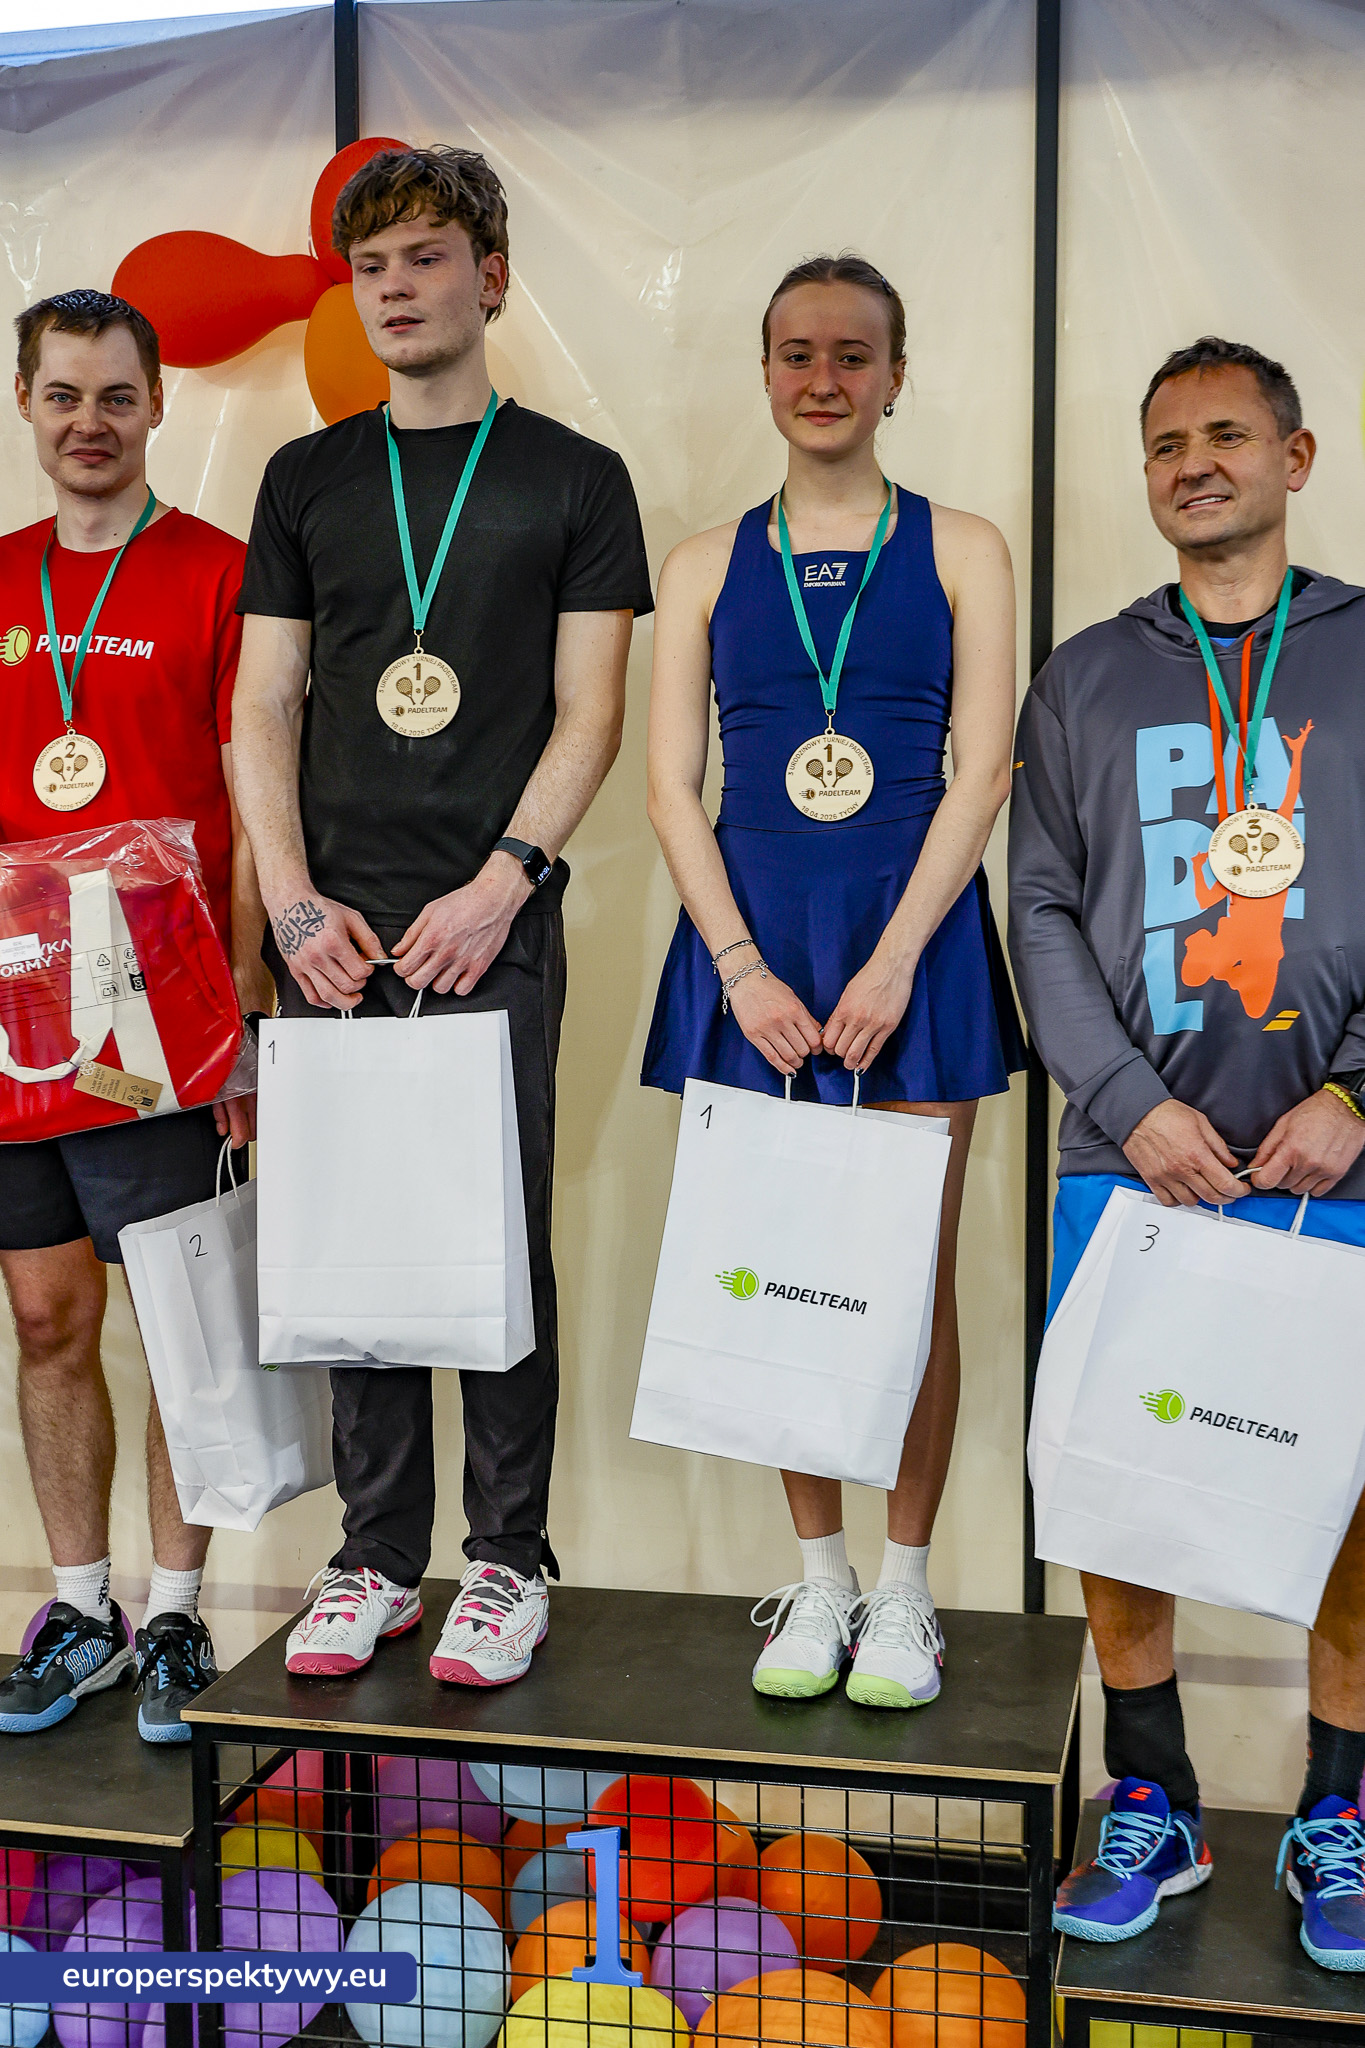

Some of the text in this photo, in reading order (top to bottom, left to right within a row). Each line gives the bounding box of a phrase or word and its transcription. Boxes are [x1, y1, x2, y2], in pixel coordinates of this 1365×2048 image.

[804, 562, 849, 581] EA7
[380, 657, 411, 690] URODZINOWY
[412, 656, 437, 665] TURNIEJ
[437, 661, 459, 694] PADELTEAM
[412, 662, 422, 681] 1
[407, 706, 448, 714] PADELTEAM
[426, 718, 446, 734] TYCHY
[64, 741, 76, 759] 2
[789, 738, 821, 772] URODZINOWY
[822, 737, 849, 746] TURNIEJ
[848, 743, 872, 776] PADELTEAM
[823, 743, 833, 763] 1
[818, 789, 861, 797] PADELTEAM
[838, 801, 859, 818] TYCHY
[1246, 818, 1262, 839] 3
[1245, 863, 1291, 873] PADELTEAM
[0, 955, 53, 978] ORMY
[268, 1039, 276, 1065] 1
[700, 1104, 713, 1130] 1
[189, 1233, 209, 1257] 2
[1139, 1224, 1161, 1252] 3
[764, 1281, 868, 1315] PADELTEAM
[1189, 1406, 1299, 1447] PADELTEAM
[566, 1826, 643, 1988] 1
